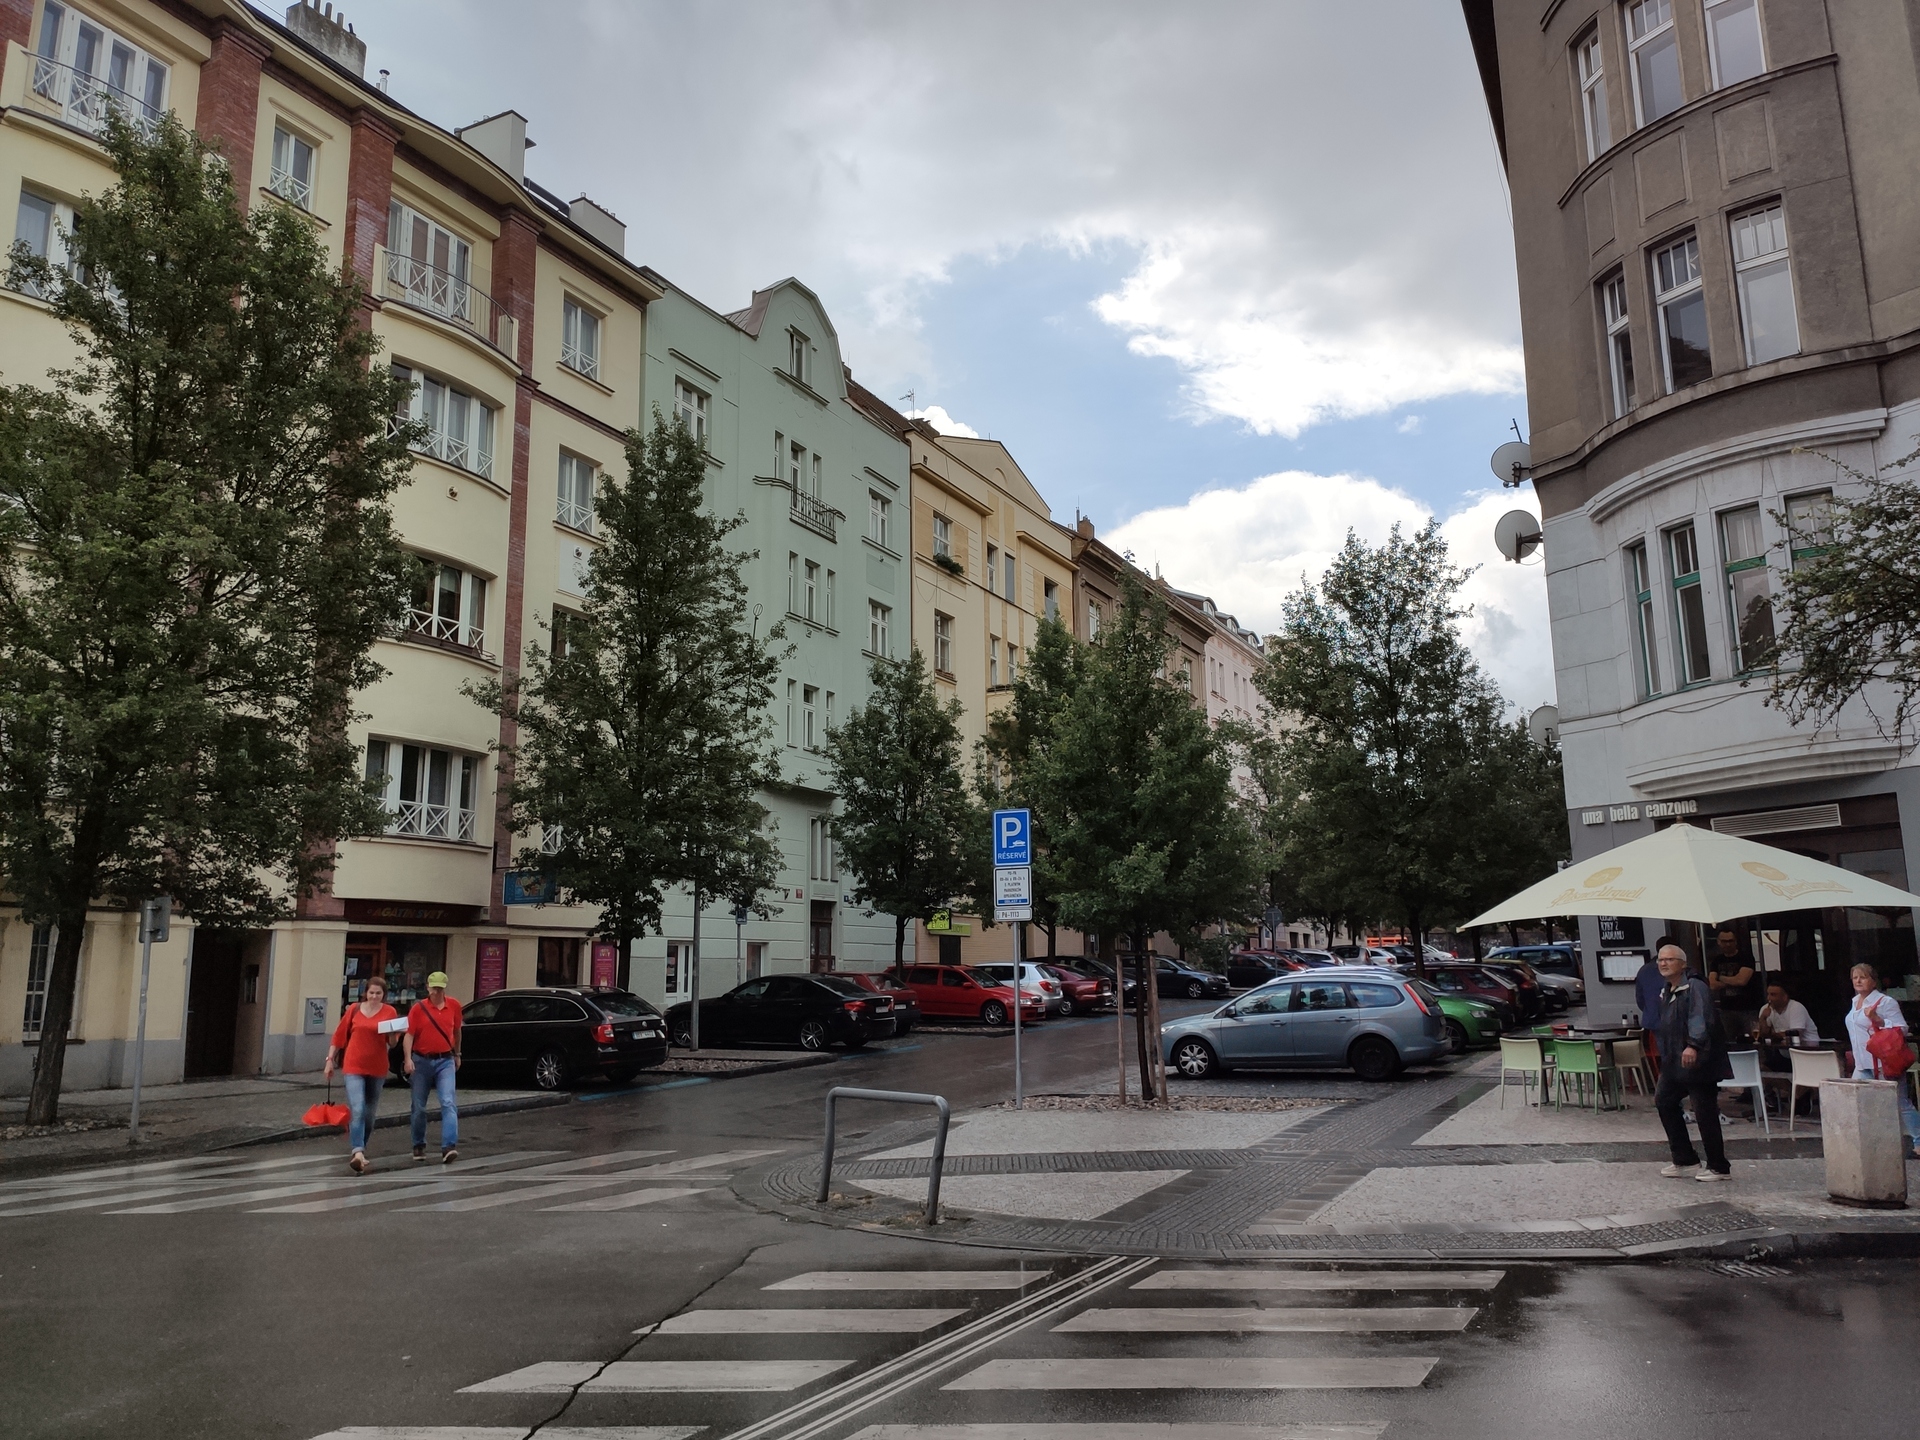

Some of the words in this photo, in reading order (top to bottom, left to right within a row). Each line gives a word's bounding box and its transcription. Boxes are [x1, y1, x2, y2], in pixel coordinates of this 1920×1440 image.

[1582, 810, 1604, 825] una
[1610, 805, 1639, 822] bella
[1645, 799, 1697, 818] canzone
[1001, 817, 1022, 848] P
[998, 850, 1026, 860] RÉSERVÉ
[1597, 886, 1647, 902] Urquell
